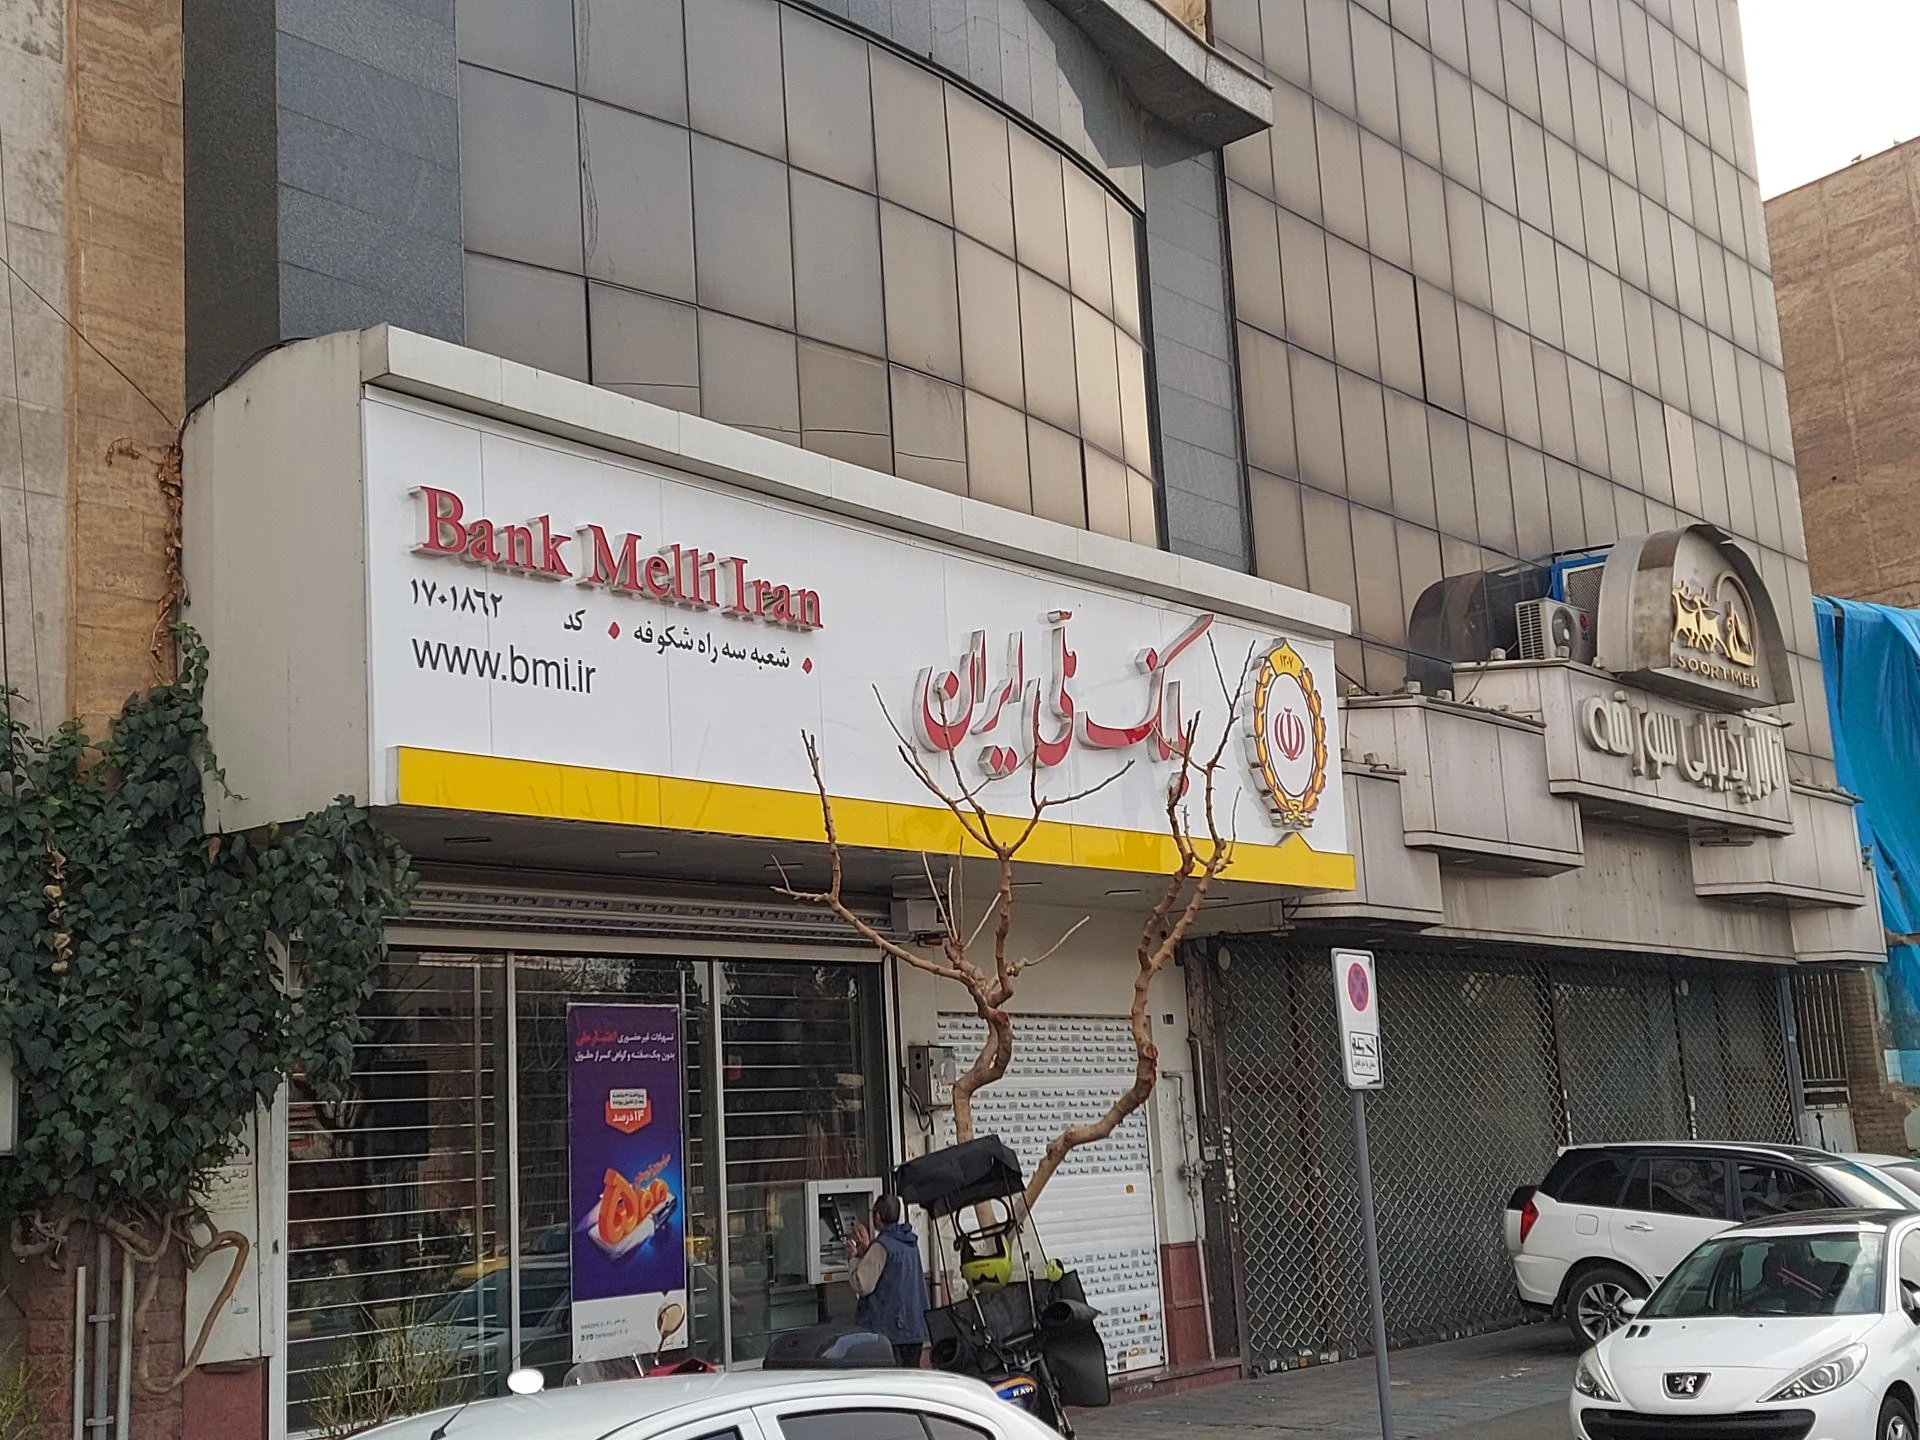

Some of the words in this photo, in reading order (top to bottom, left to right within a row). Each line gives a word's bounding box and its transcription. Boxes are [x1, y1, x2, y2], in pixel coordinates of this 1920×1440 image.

[409, 485, 573, 581] Bank
[576, 524, 721, 612] Melli
[722, 556, 825, 632] Iran
[563, 609, 586, 631] کد
[634, 620, 694, 654] شکوفه
[698, 632, 718, 663] راه
[722, 642, 746, 660] سه
[750, 647, 790, 670] شعبه
[411, 638, 596, 693] www.bmi.ir
[1677, 655, 1760, 689] SOORTMEH
[912, 629, 1024, 779] ایران
[1075, 613, 1215, 799] بانک
[1582, 690, 1677, 780] سورتمه
[612, 1112, 634, 1125] درصد
